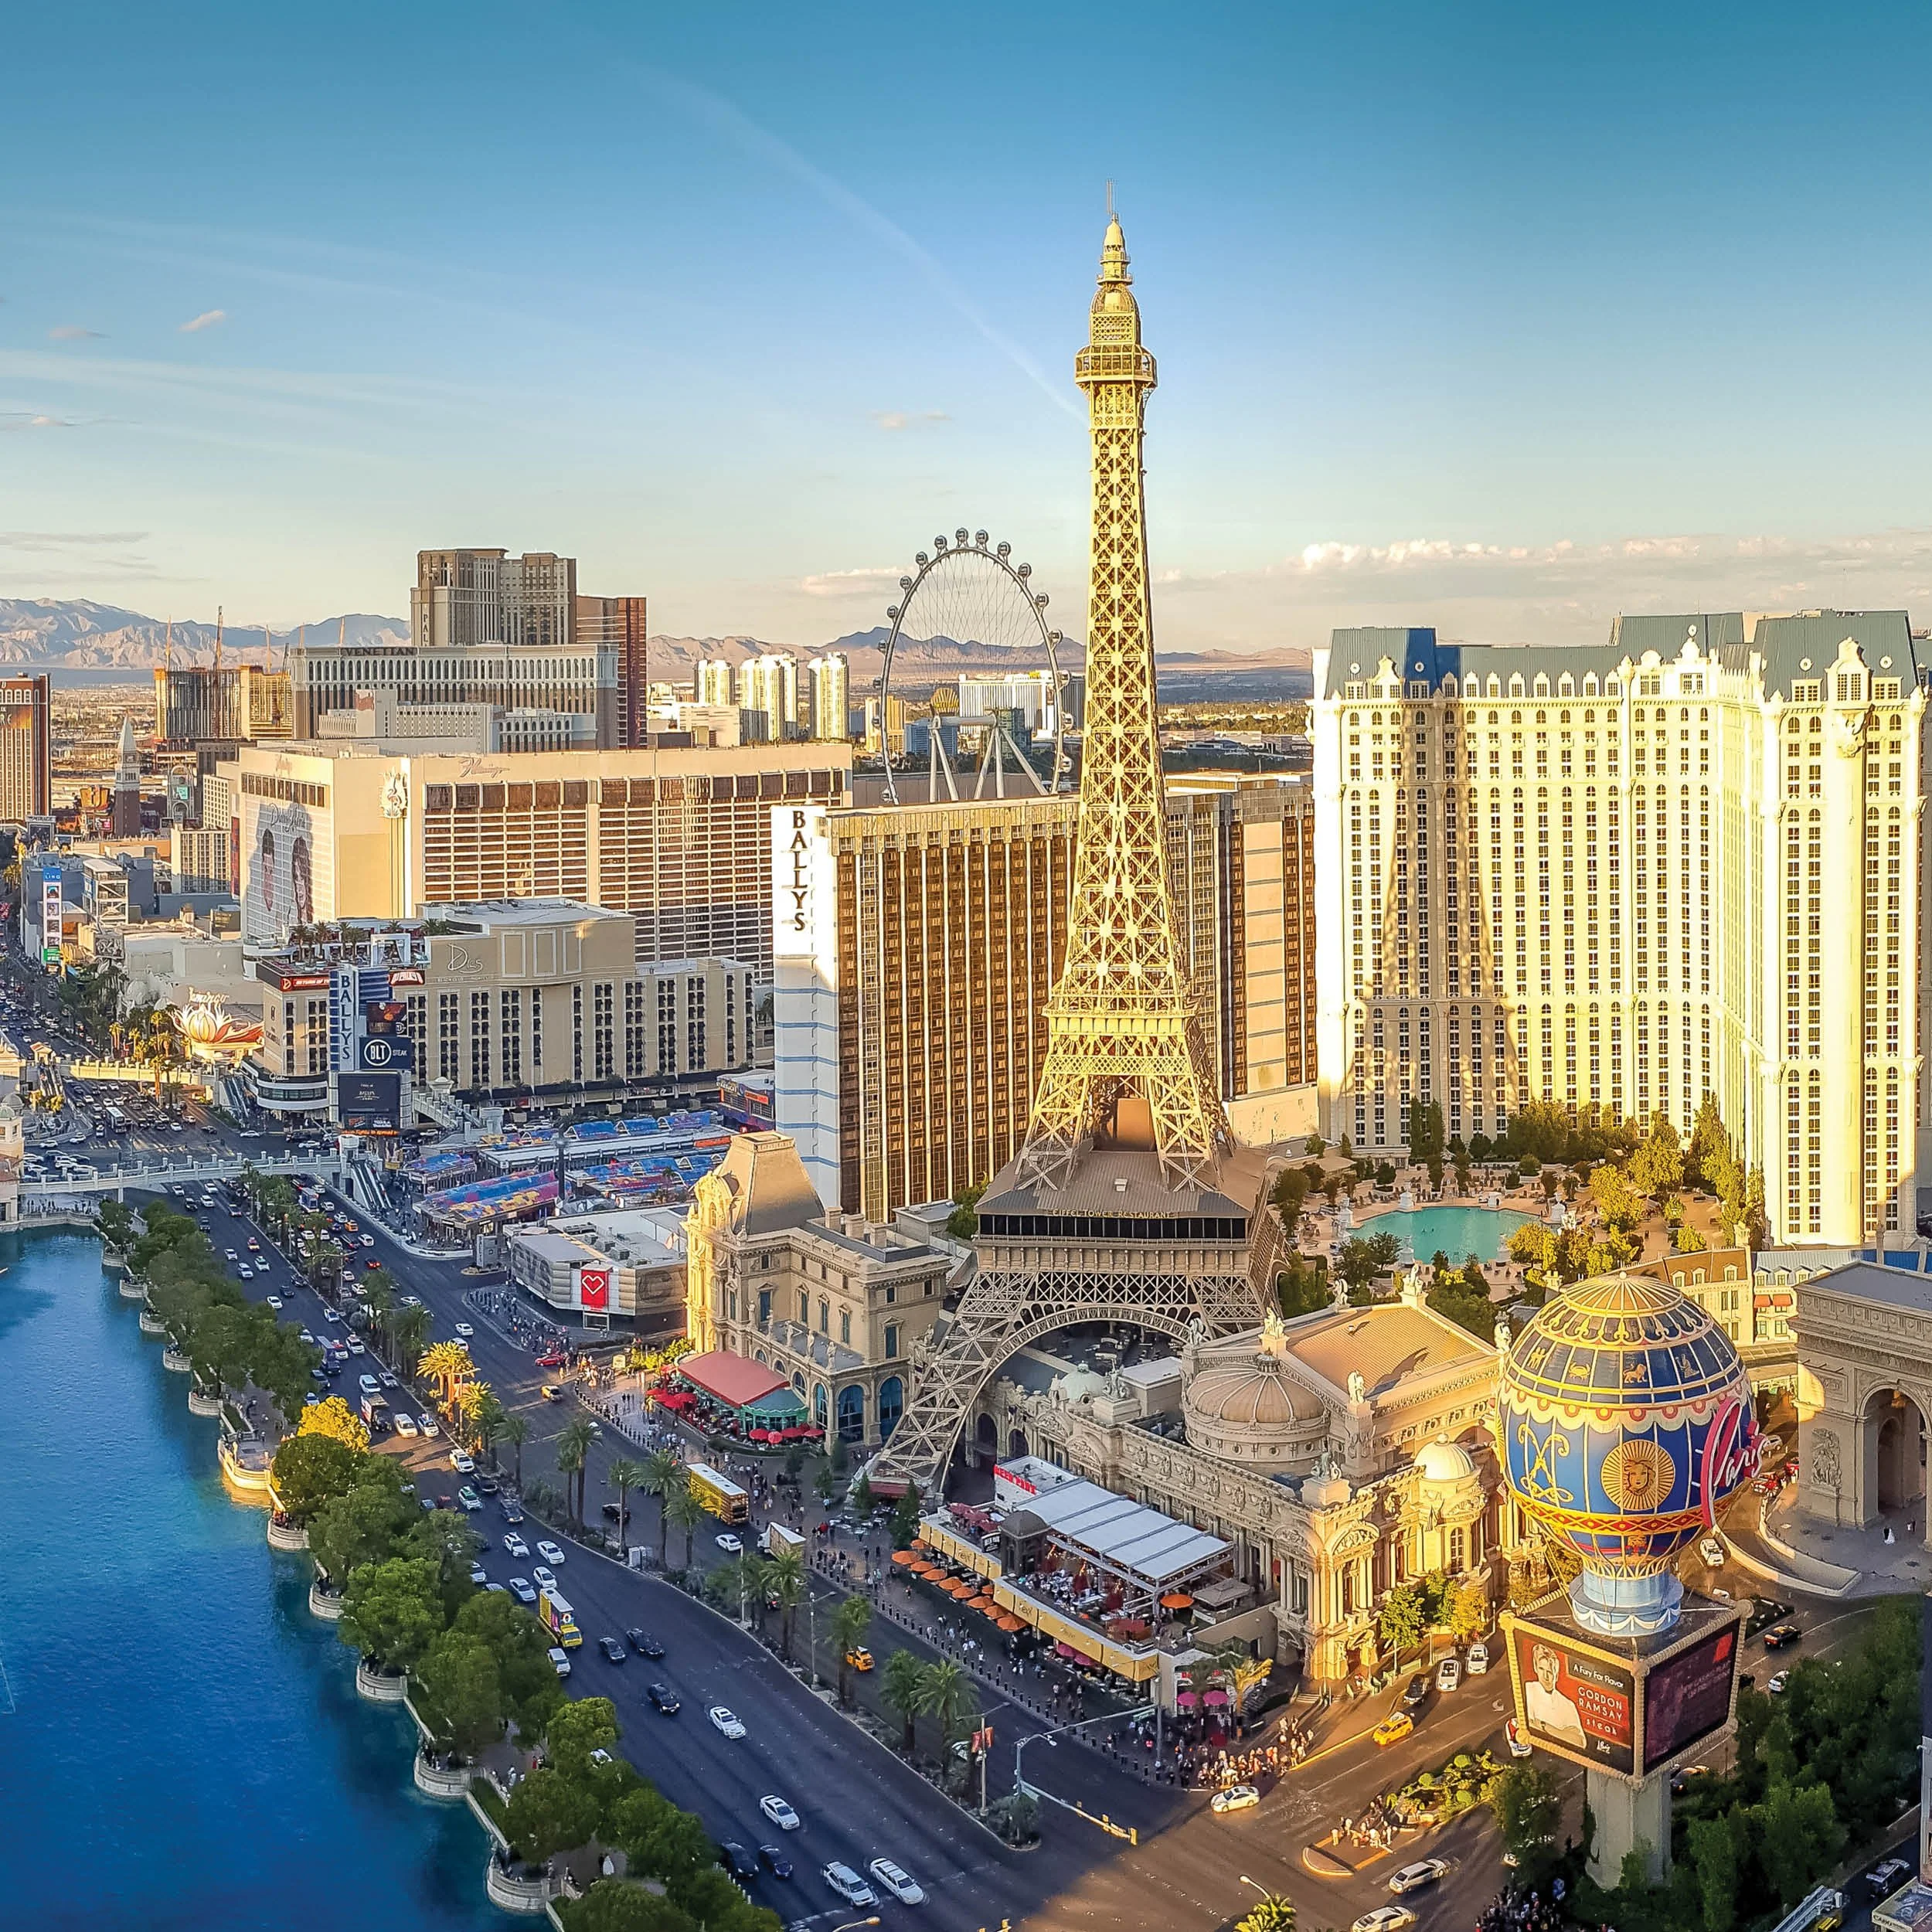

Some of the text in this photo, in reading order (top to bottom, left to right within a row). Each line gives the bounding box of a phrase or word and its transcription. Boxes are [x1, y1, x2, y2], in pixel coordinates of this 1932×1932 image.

[790, 810, 808, 931] BALLYS
[340, 975, 352, 1060] BALLYS
[370, 1045, 386, 1060] BLT
[1053, 1208, 1171, 1219] EIFFEL TOWER RESTAURANT
[1573, 1663, 1624, 1689] A Fury For Flavor
[1577, 1686, 1622, 1710] GORDON
[1579, 1698, 1623, 1721] RAMSAY
